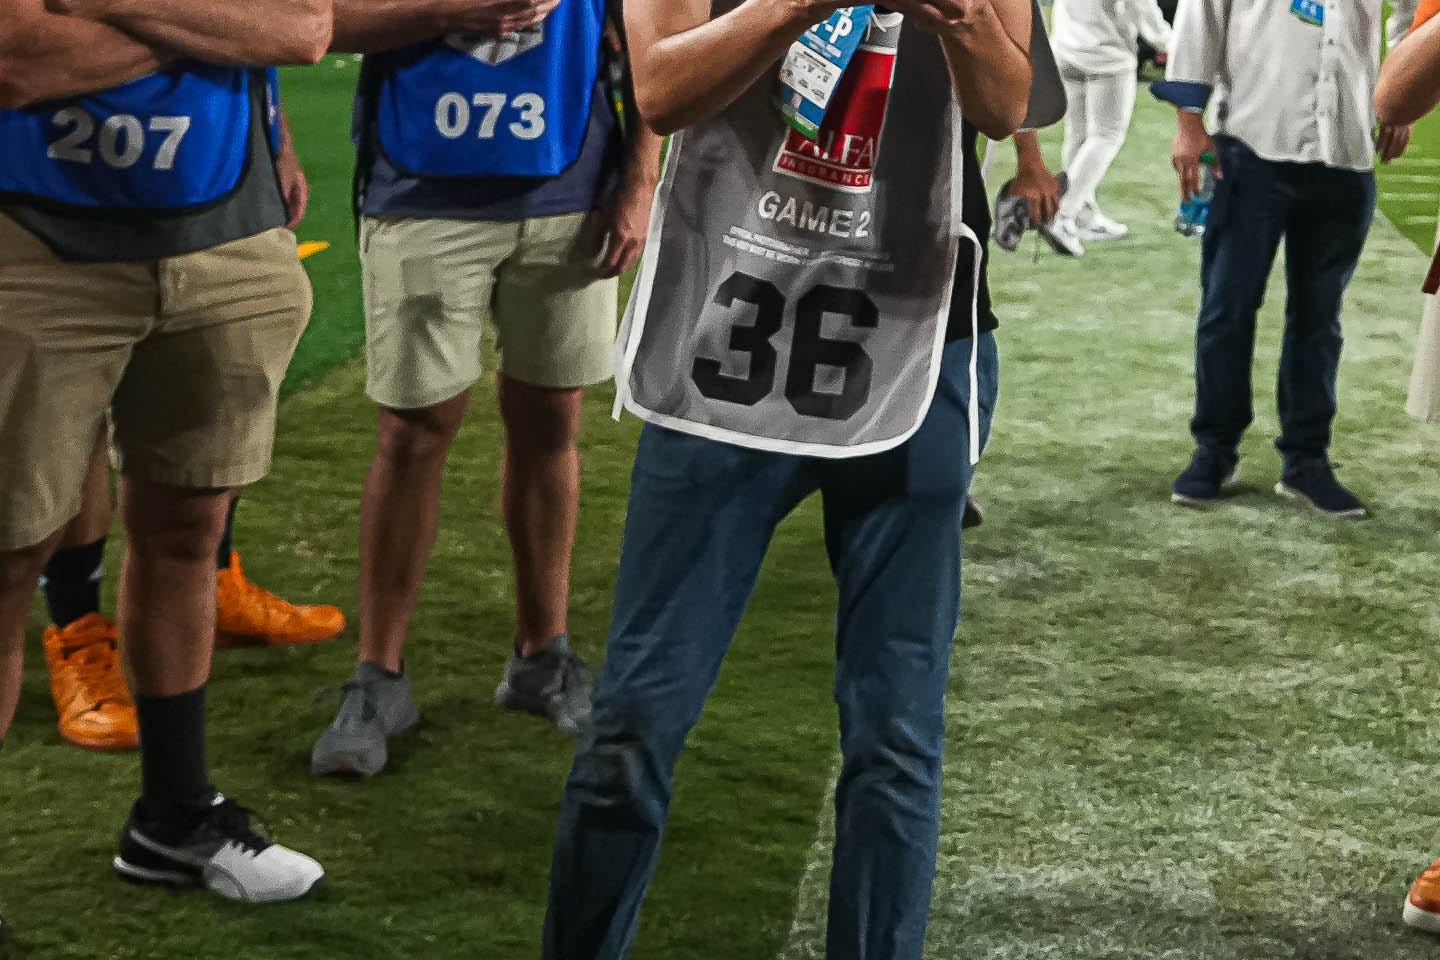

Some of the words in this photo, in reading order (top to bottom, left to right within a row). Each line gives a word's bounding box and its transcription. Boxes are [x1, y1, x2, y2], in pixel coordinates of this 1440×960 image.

[811, 14, 853, 44] -P
[46, 107, 191, 170] 207
[435, 91, 545, 139] 073
[759, 190, 853, 238] GAME
[855, 210, 871, 237] 2
[691, 271, 879, 421] 36
